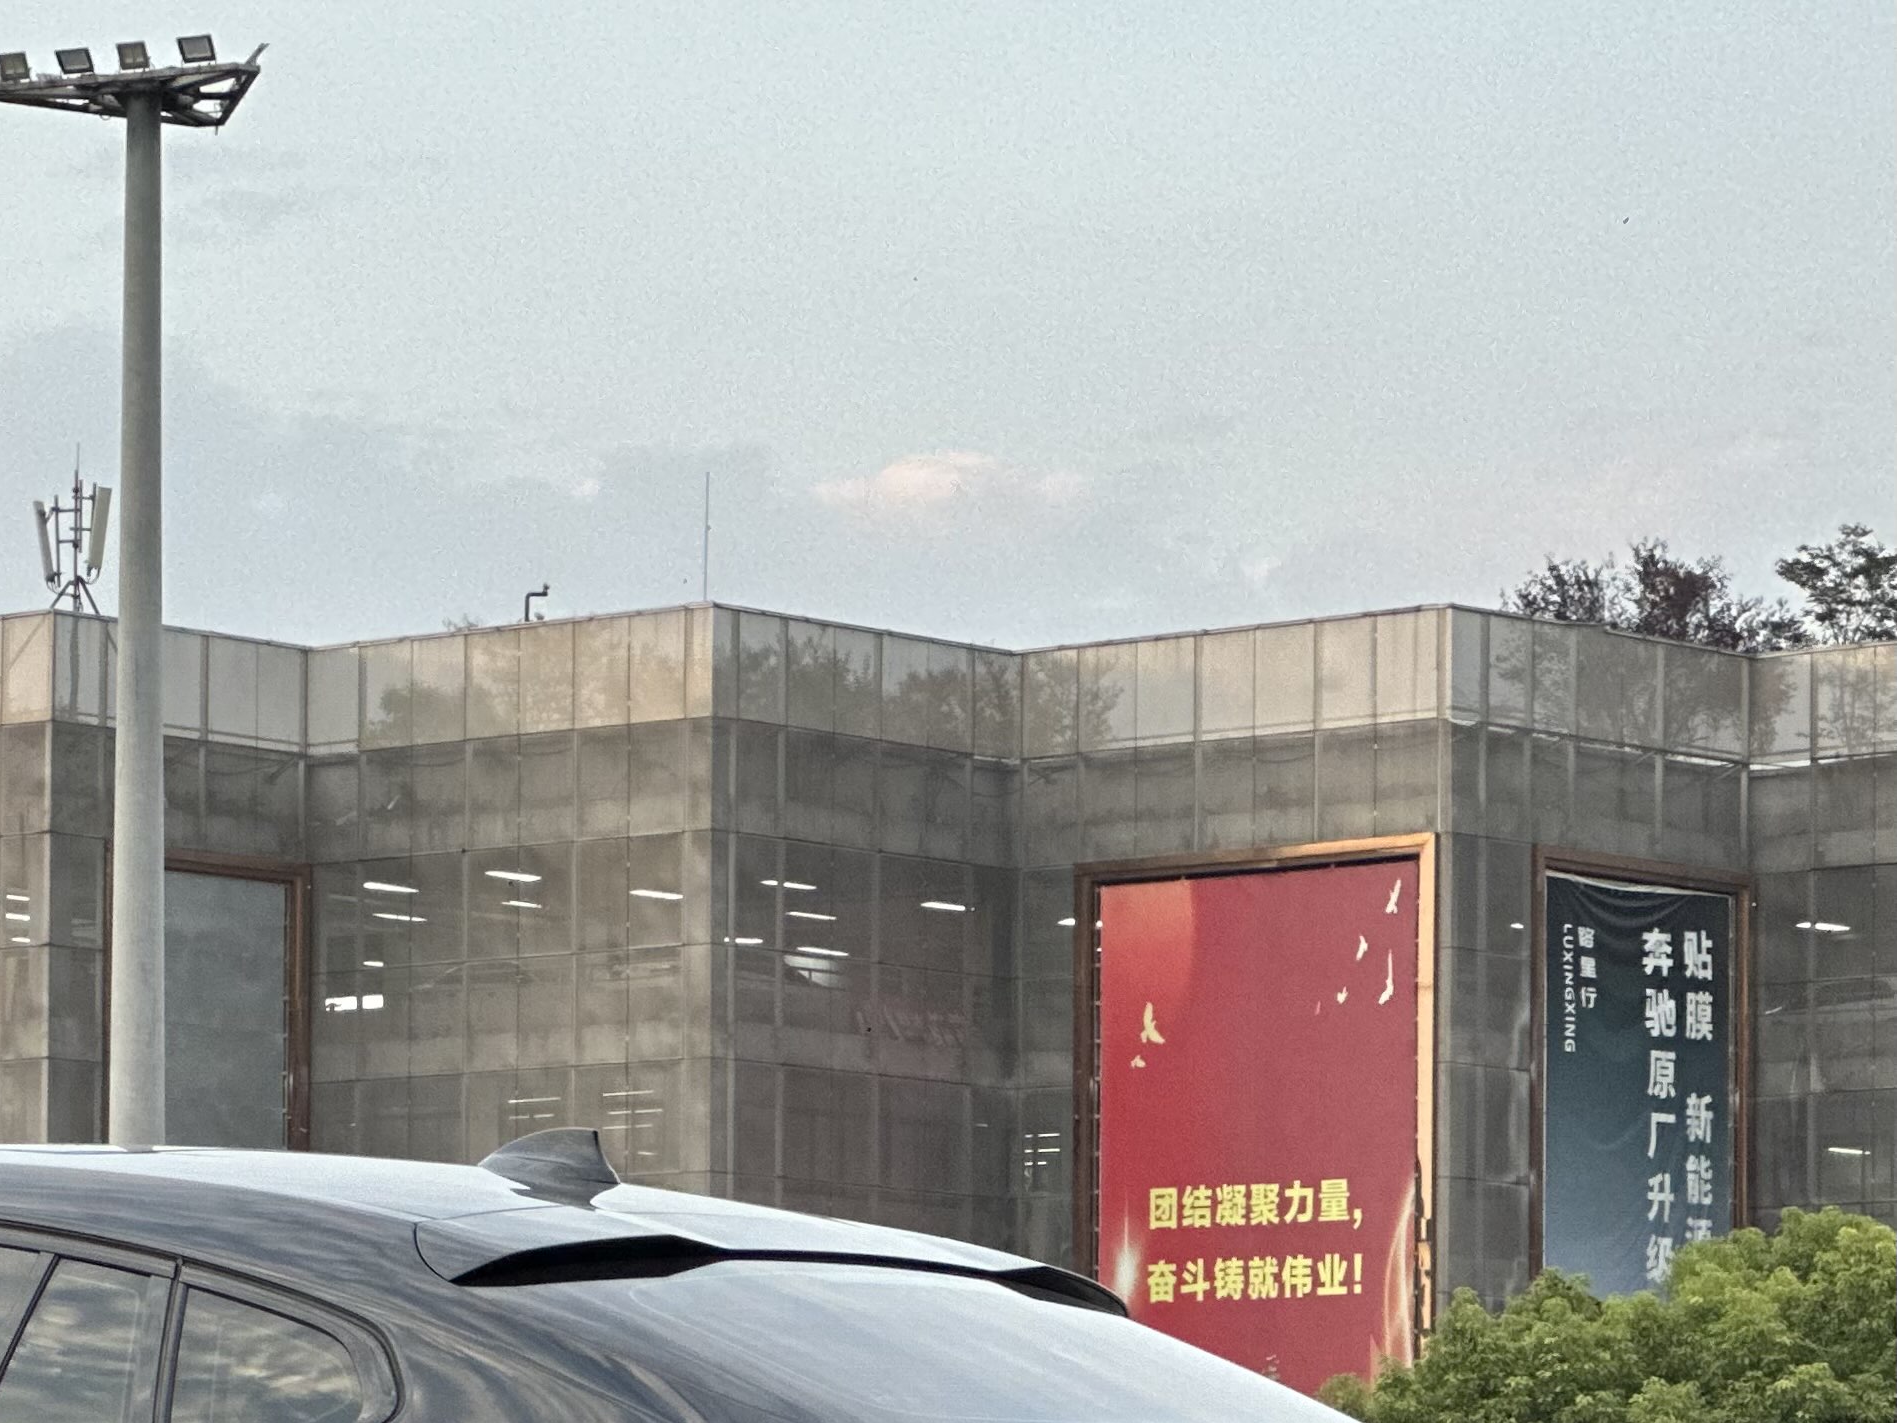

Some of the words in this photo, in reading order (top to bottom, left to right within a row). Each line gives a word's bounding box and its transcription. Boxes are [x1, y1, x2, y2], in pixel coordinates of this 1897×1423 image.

[1563, 923, 1576, 1053] LUXINGXING
[1683, 930, 1713, 1041] 贴膜
[1641, 927, 1676, 1284] 奔驰原厂升级
[1147, 1253, 1363, 1303] 奋斗铸就伟业！
